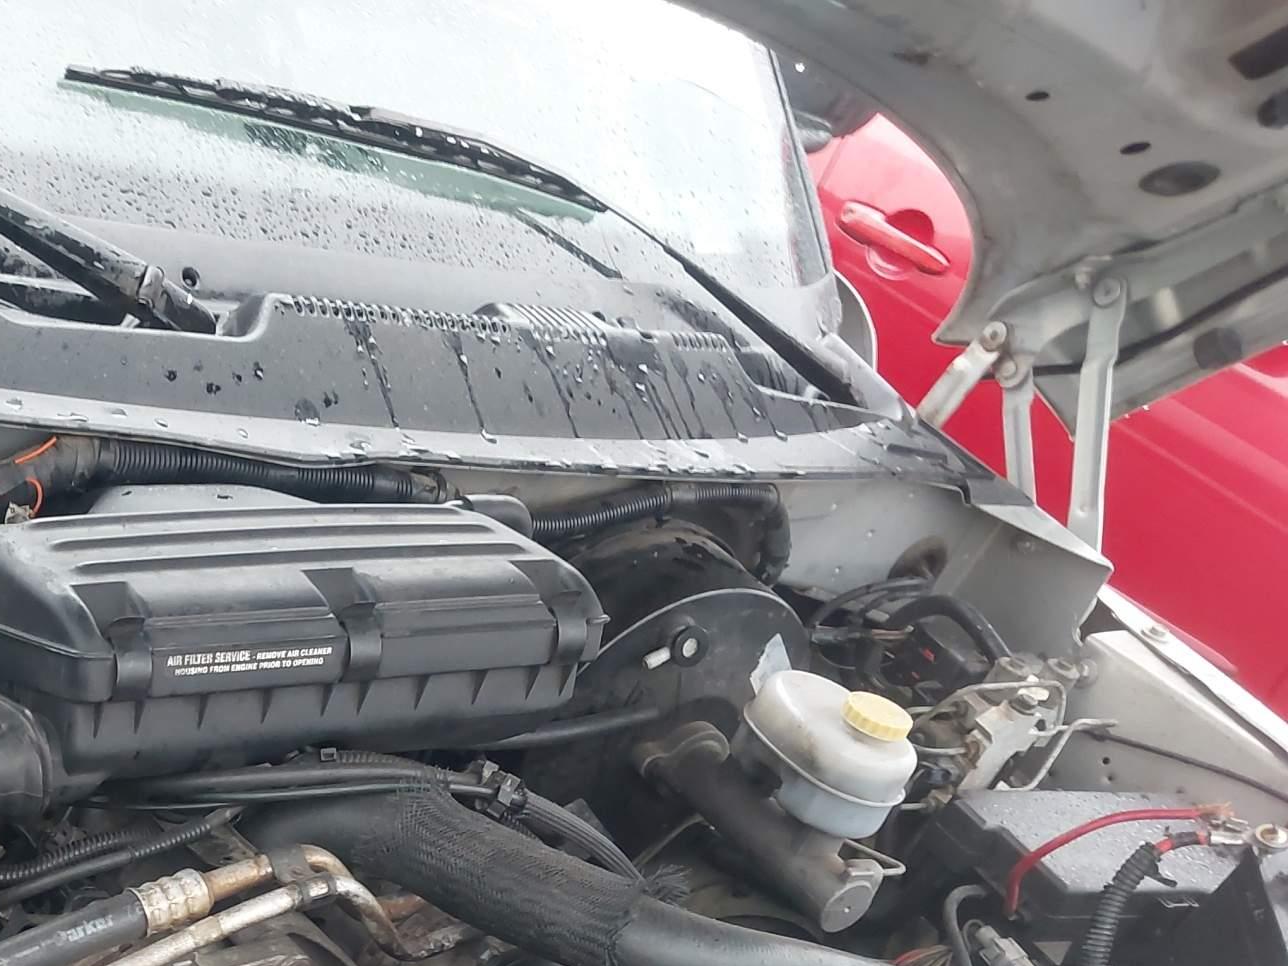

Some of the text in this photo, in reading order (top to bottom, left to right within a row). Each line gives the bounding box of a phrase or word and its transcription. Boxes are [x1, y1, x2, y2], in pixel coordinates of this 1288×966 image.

[167, 655, 182, 667] AIR
[184, 653, 213, 666] FILTER
[215, 651, 251, 663] SERVICE
[256, 650, 286, 660] REMOVE
[287, 649, 299, 658] AIR
[300, 646, 332, 657] CLEANER
[175, 657, 324, 676] HOUSING FROM ENGINE PRIOR TO OPENING
